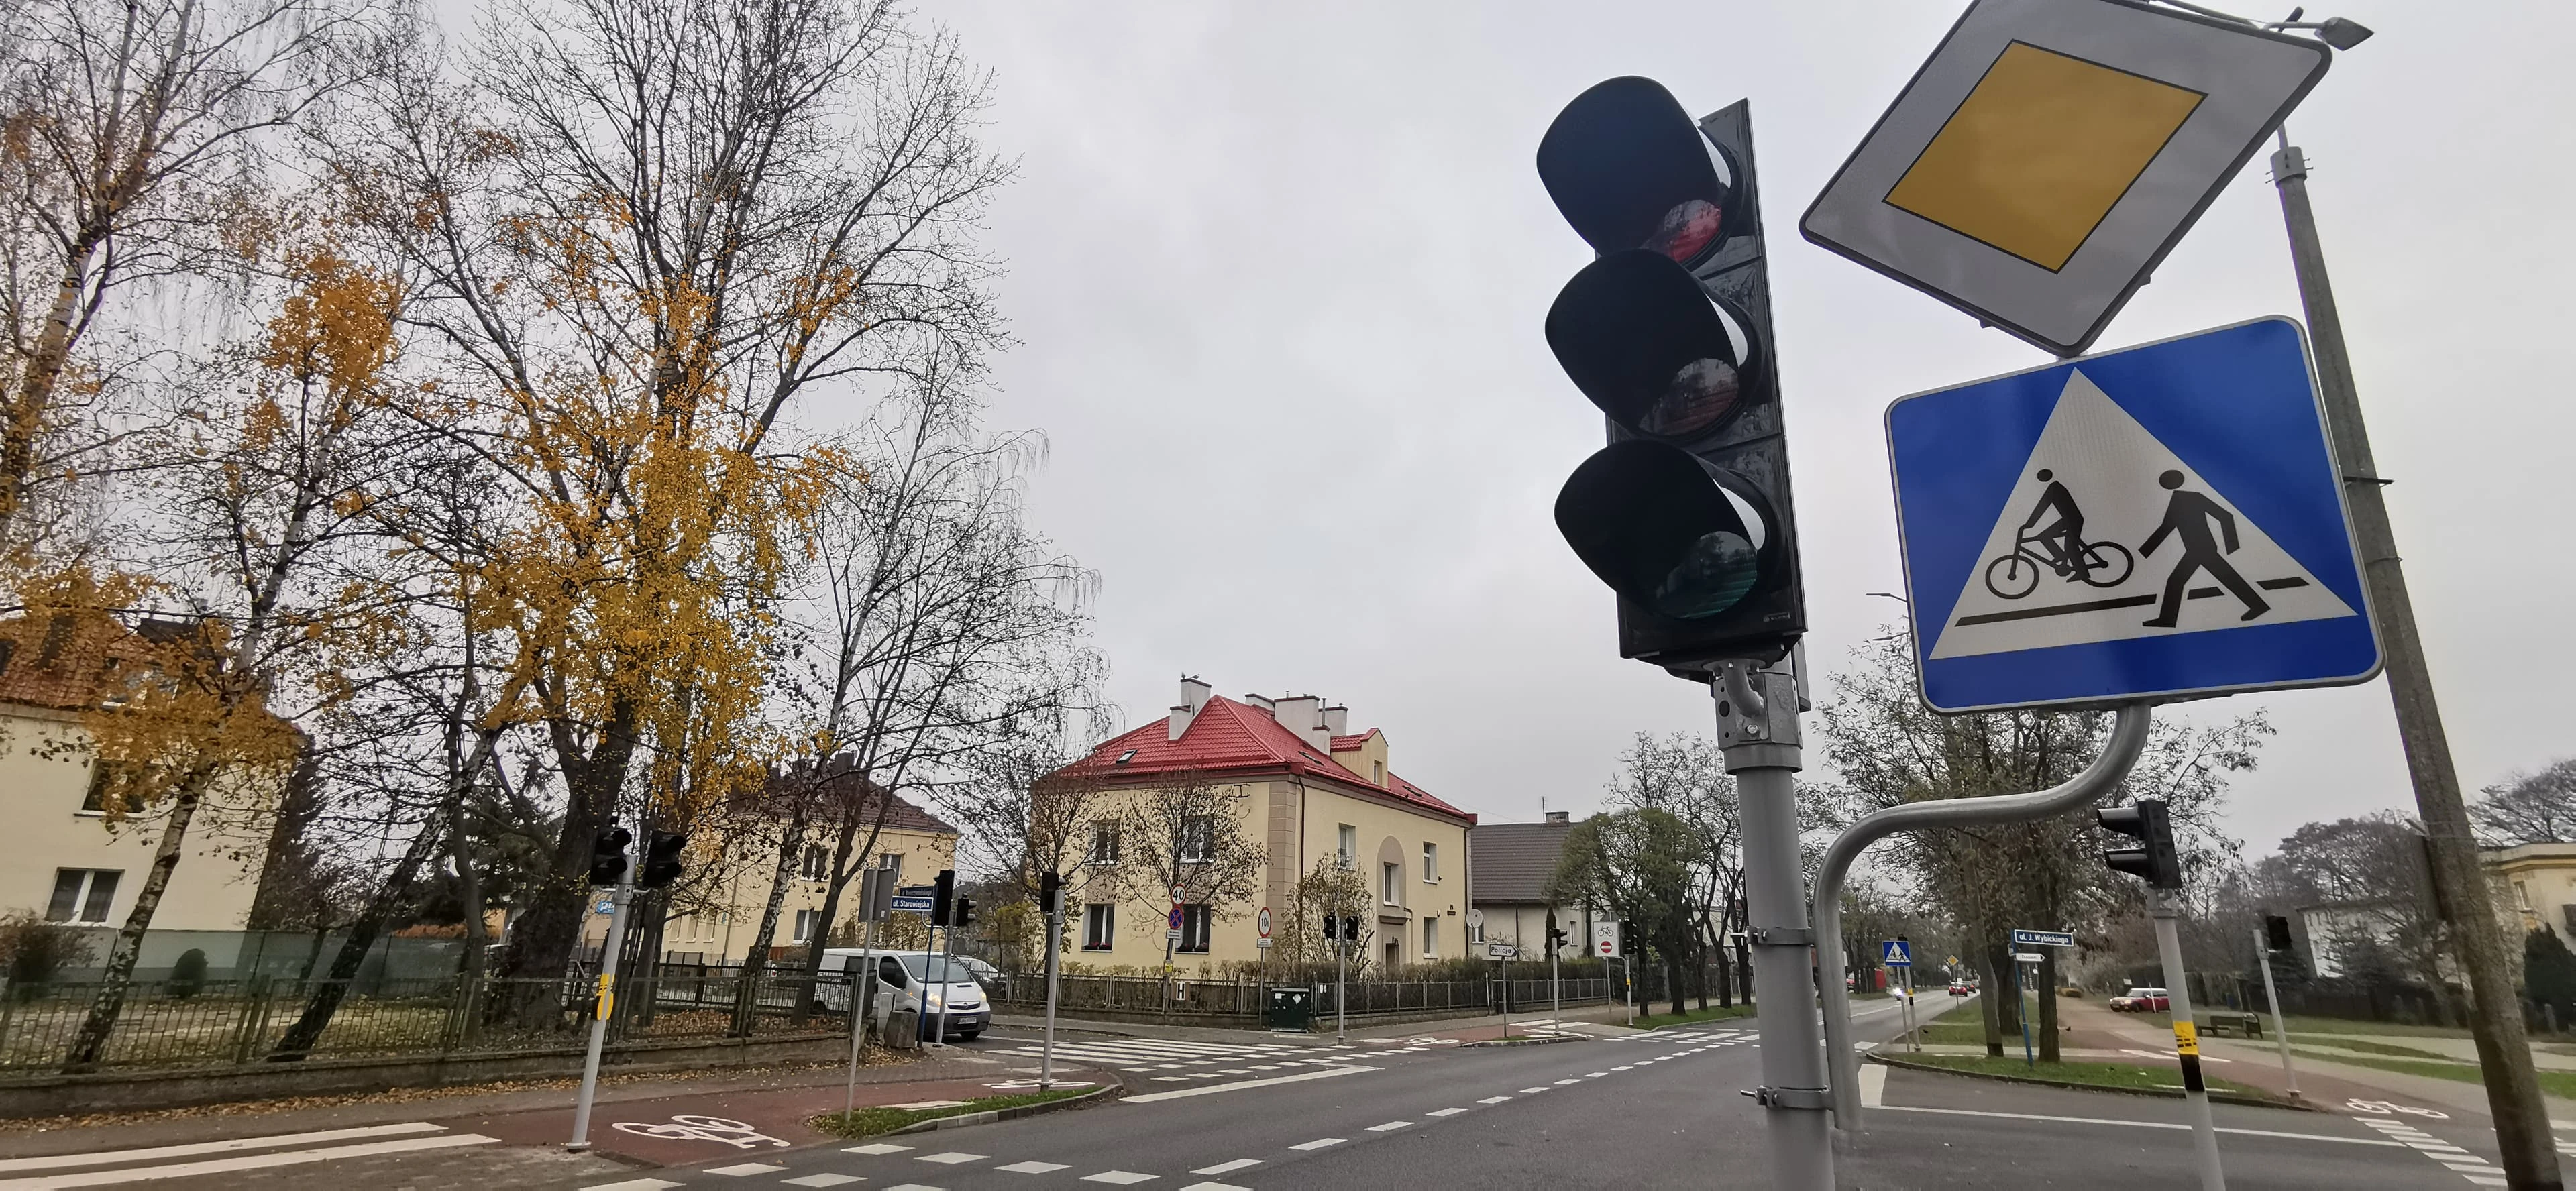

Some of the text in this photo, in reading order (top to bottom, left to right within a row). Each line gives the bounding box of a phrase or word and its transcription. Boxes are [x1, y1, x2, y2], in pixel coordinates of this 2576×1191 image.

[1173, 889, 1184, 901] 40
[900, 900, 930, 909] Starowiejska
[2035, 934, 2069, 944] Wybickiego
[1491, 946, 1511, 954] Policja
